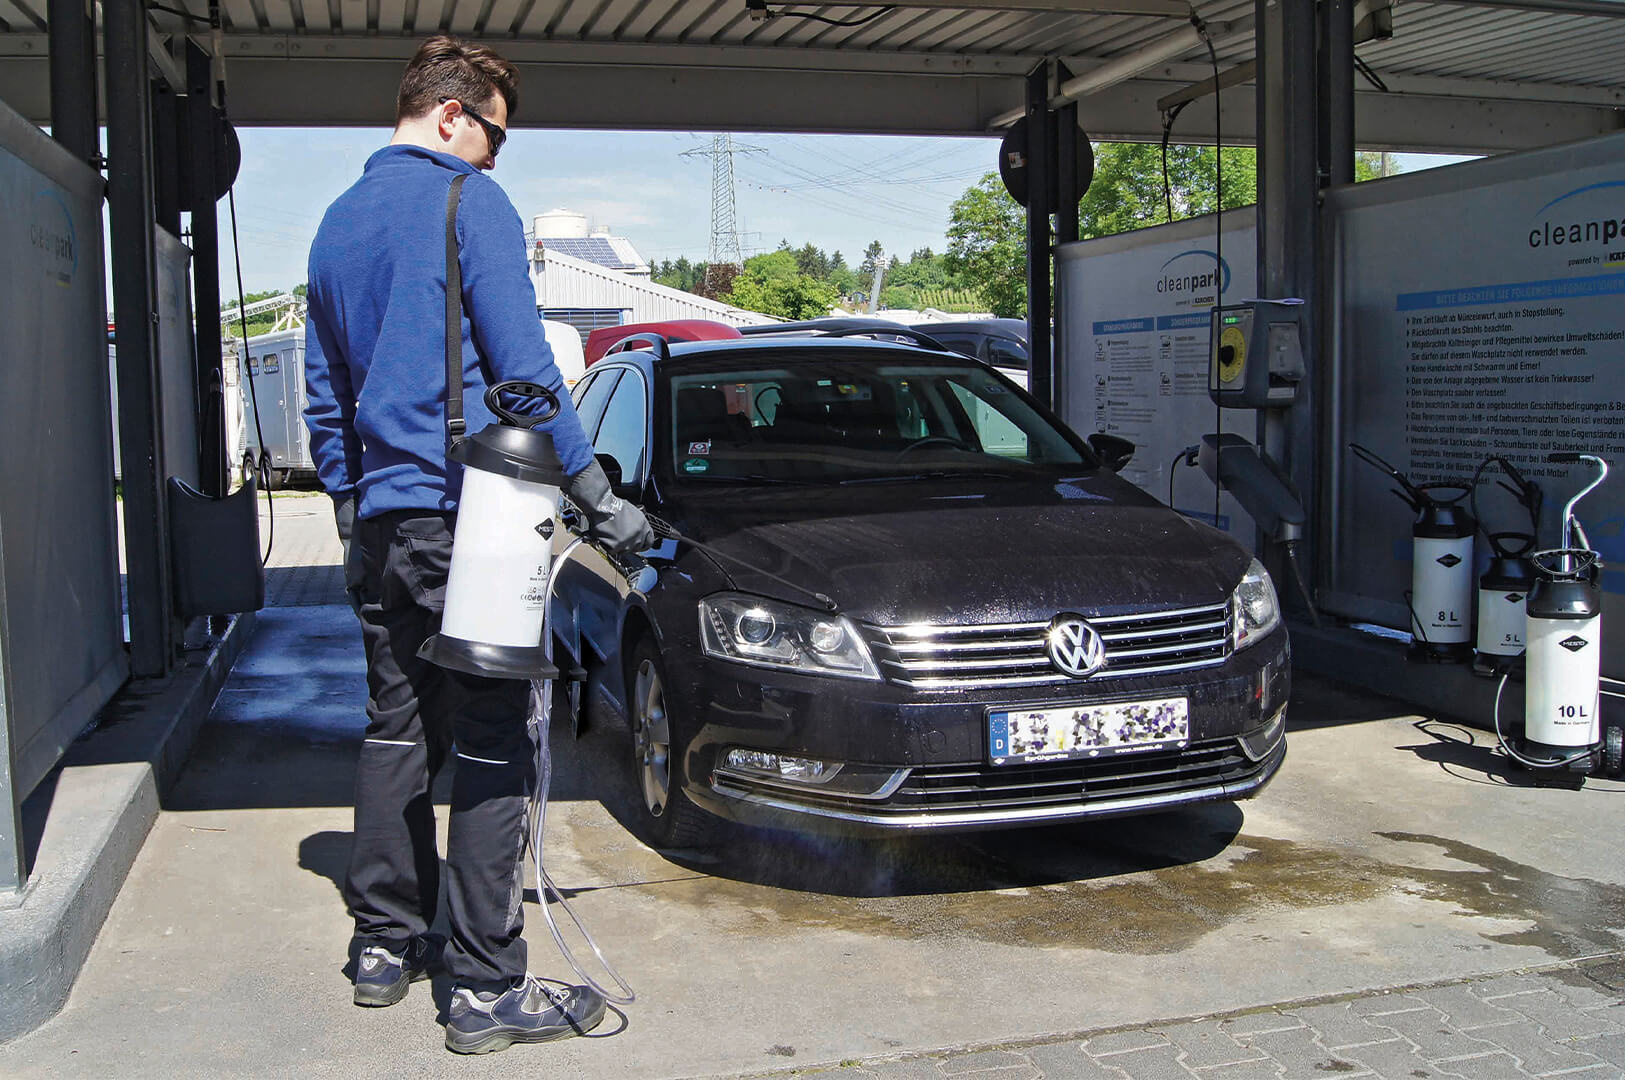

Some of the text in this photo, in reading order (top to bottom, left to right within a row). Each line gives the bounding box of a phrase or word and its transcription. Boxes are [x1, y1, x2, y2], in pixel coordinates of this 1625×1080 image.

[1568, 256, 1592, 266] powered
[1593, 256, 1600, 264] by
[1608, 401, 1614, 410] &
[537, 566, 542, 575] 5
[1438, 611, 1458, 621] 8 L
[1558, 705, 1588, 718] 10 L
[995, 739, 1004, 750] D
